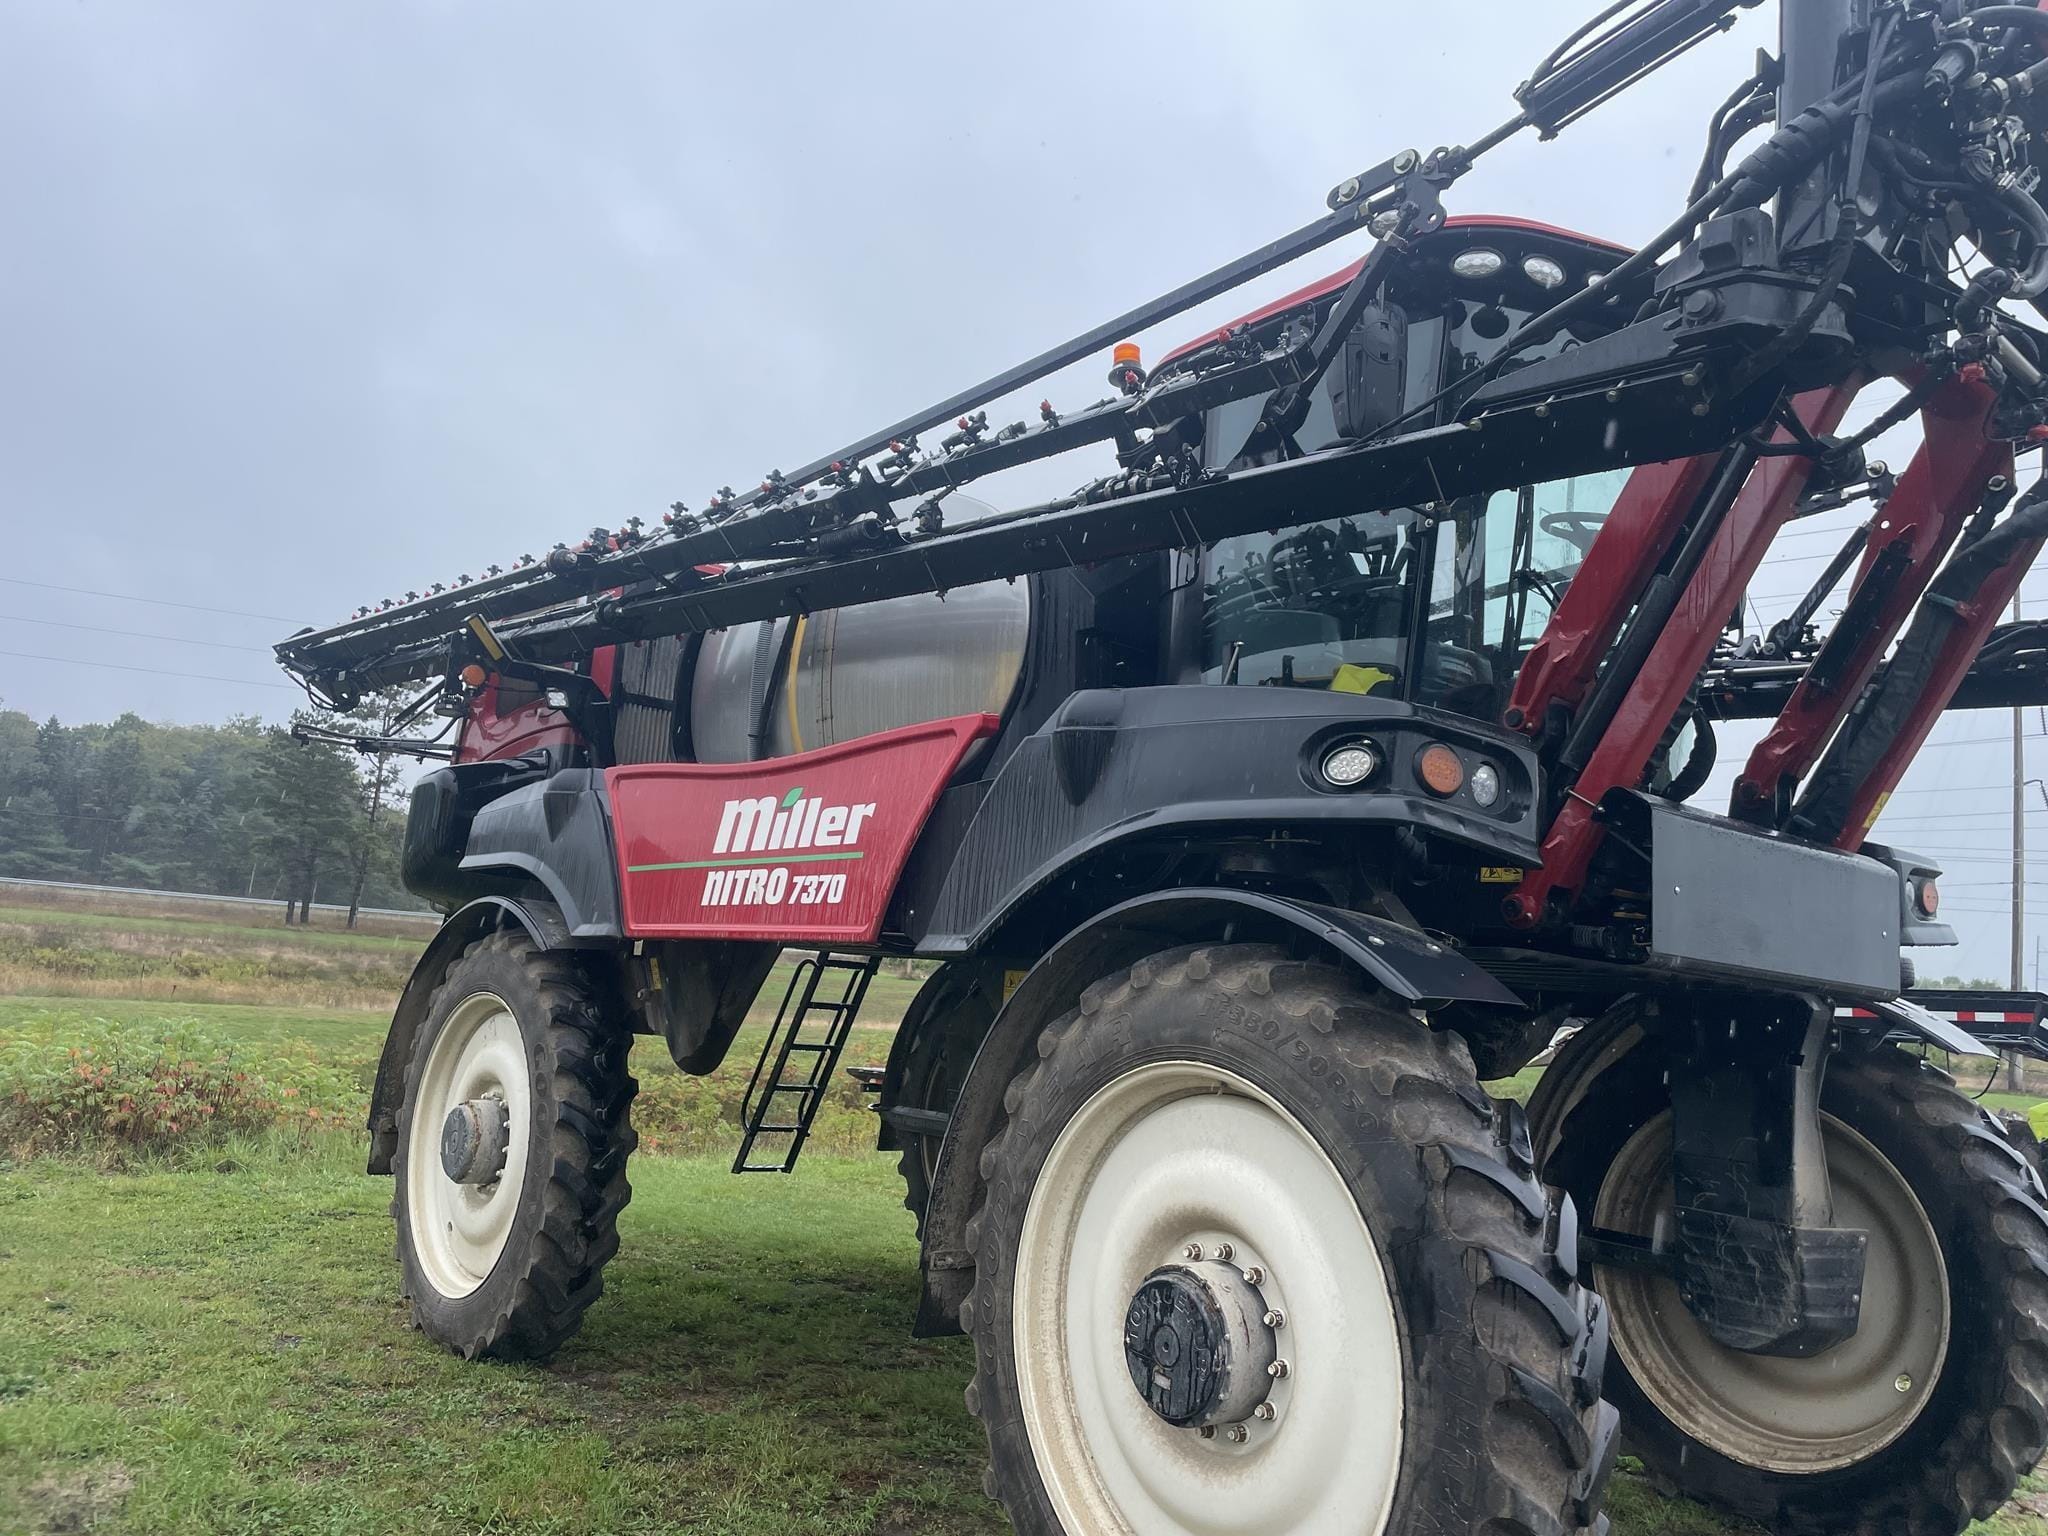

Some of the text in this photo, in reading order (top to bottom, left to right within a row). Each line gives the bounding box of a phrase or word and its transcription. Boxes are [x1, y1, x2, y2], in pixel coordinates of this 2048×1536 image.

[712, 788, 877, 854] Miller
[700, 867, 847, 906] NITRO 7370
